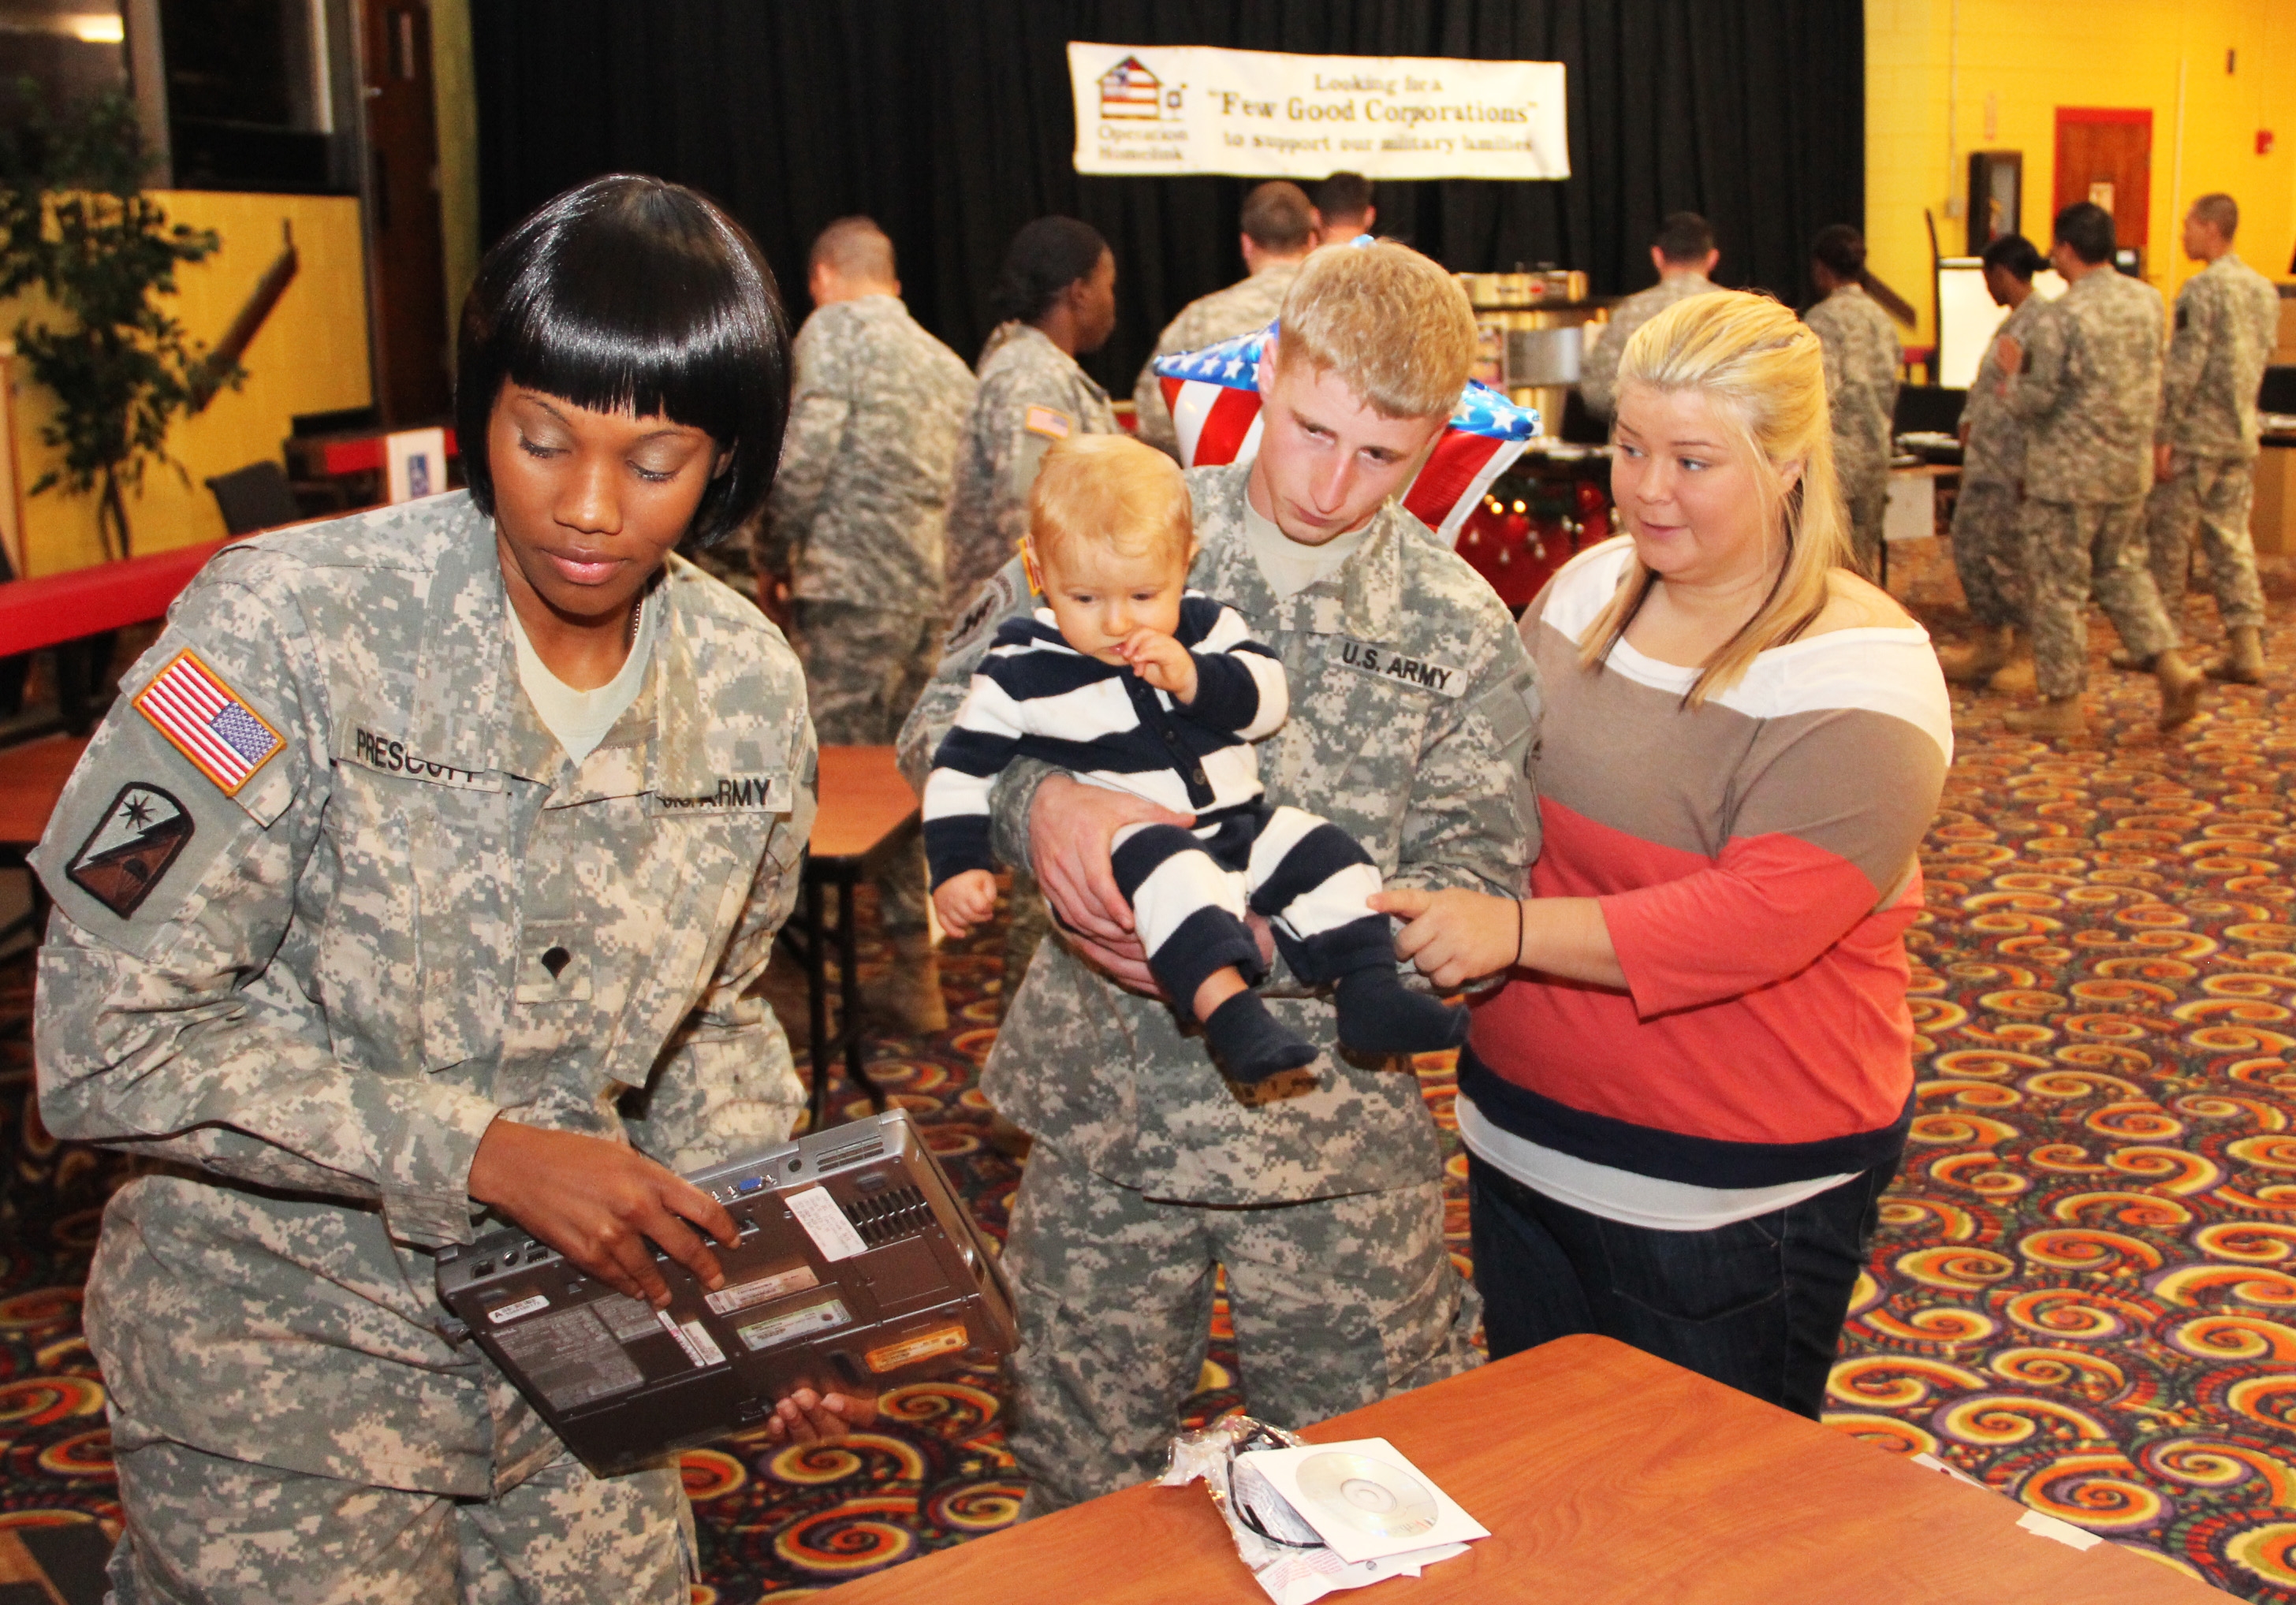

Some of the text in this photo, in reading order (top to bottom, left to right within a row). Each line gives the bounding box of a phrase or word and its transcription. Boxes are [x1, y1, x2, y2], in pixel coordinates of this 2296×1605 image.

[1314, 73, 1397, 96] Looking
[1287, 96, 1356, 121] Good
[1224, 131, 1245, 148] to
[1252, 135, 1331, 155] support
[1340, 139, 1373, 152] our
[1381, 133, 1456, 155] military
[1342, 642, 1452, 690] U.S. ARMY
[356, 728, 473, 783] PRESC
